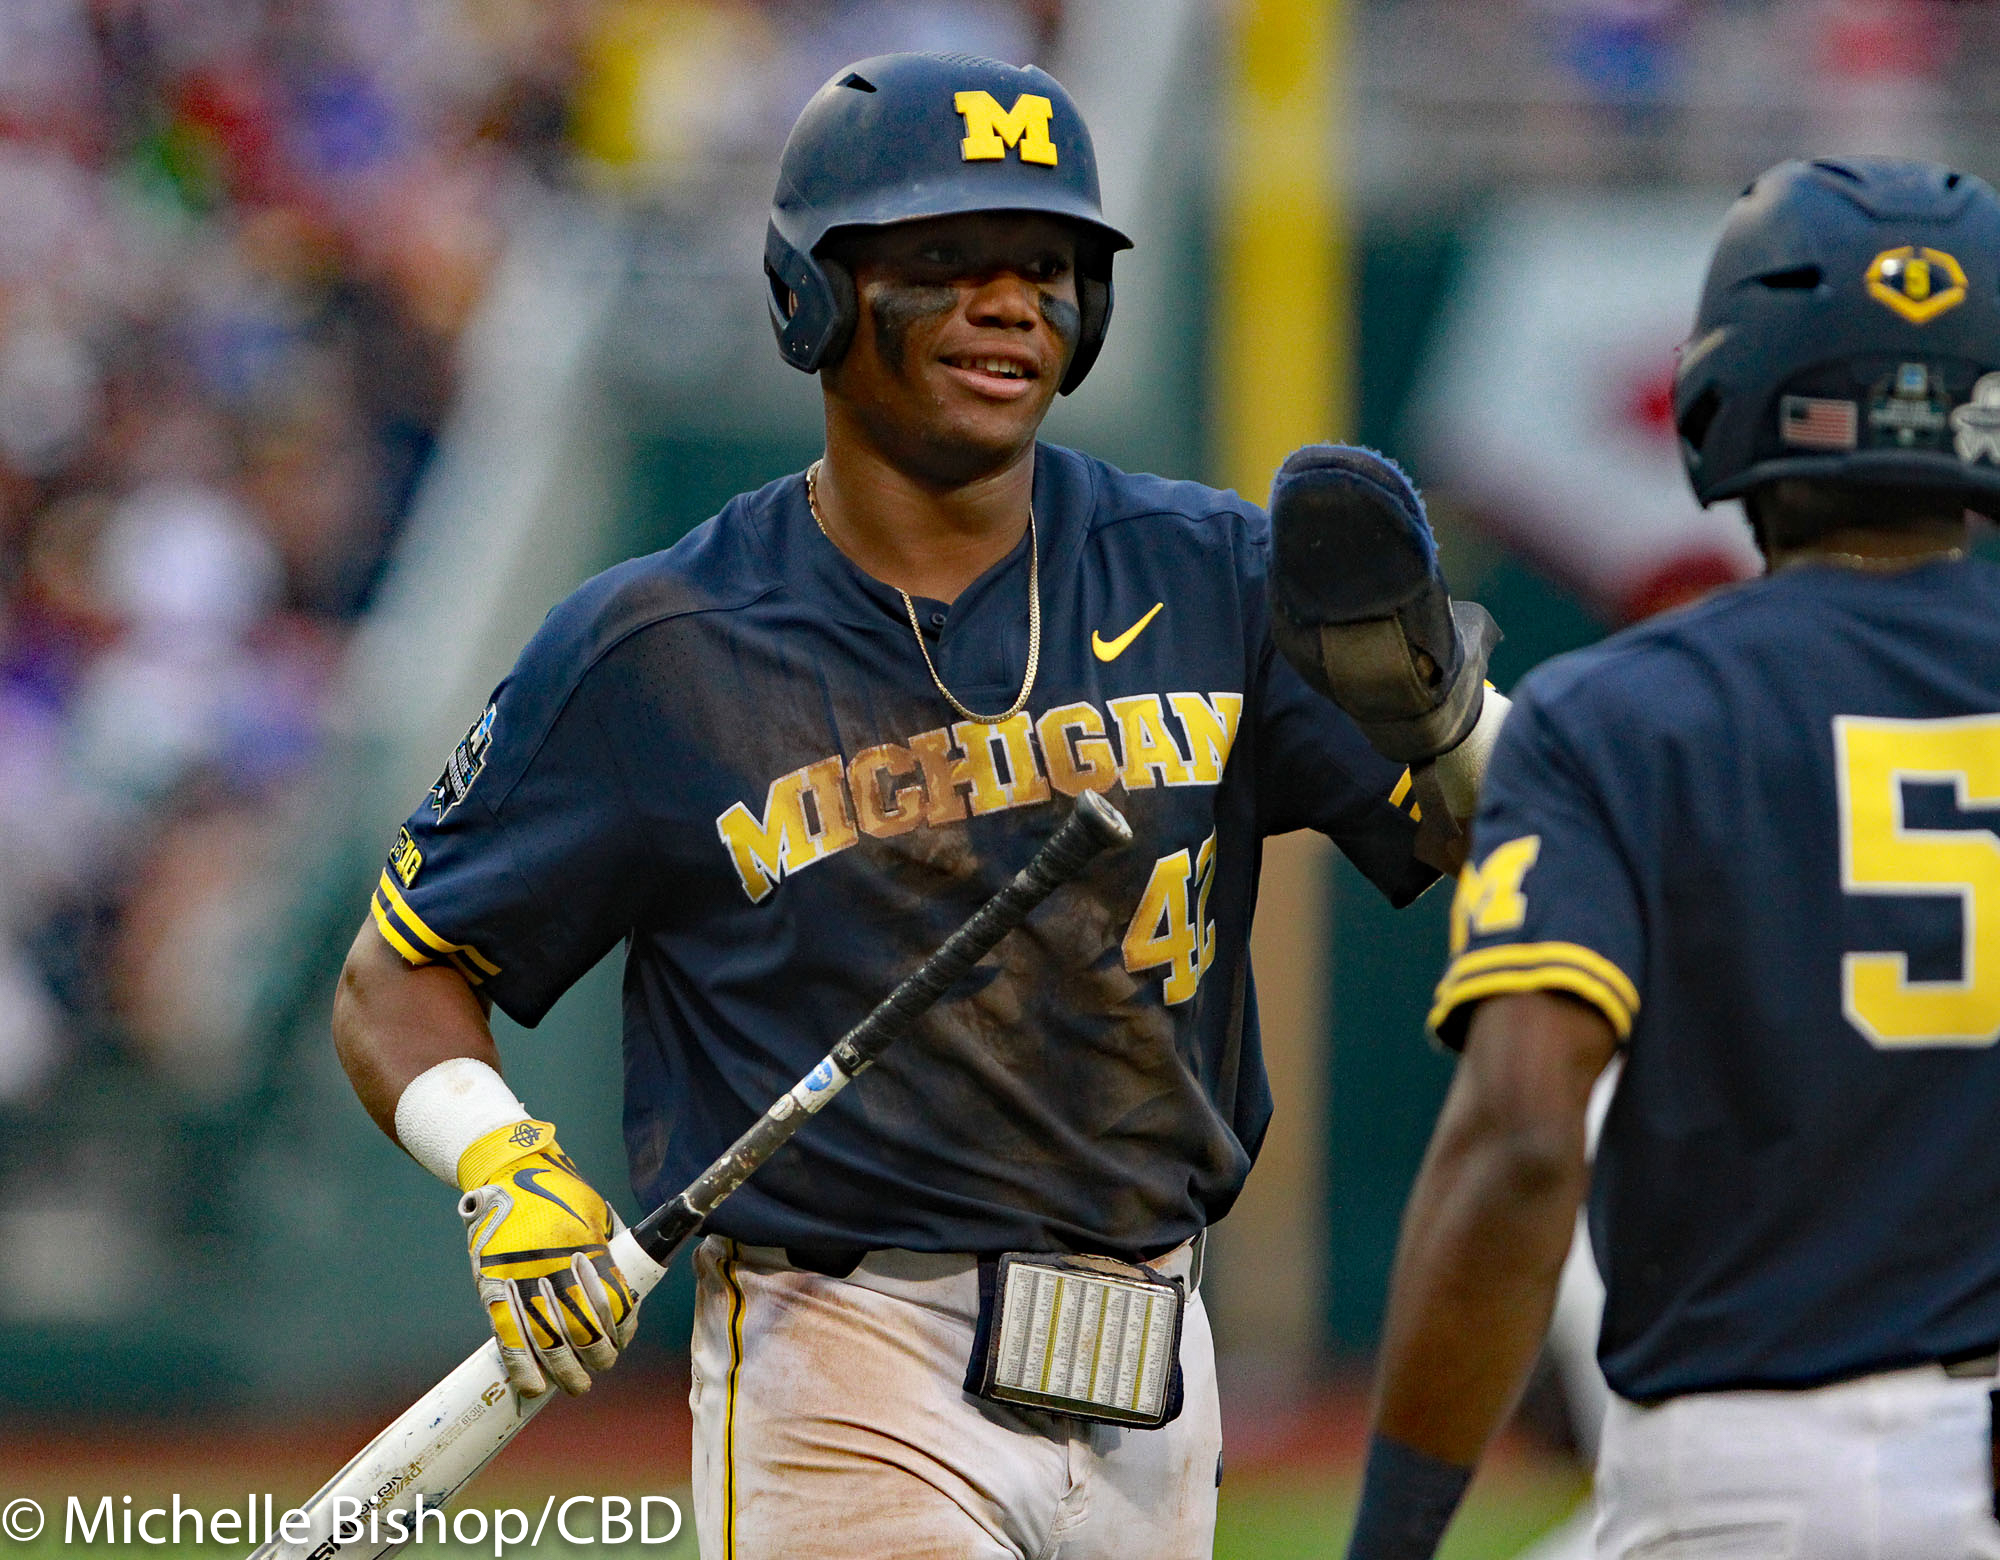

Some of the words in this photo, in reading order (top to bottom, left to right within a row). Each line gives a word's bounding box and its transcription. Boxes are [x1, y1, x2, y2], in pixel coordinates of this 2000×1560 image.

[954, 90, 1058, 166] M
[716, 691, 1244, 904] MICHIGAN
[1449, 835, 1541, 956] M
[1832, 713, 2000, 1050] 5
